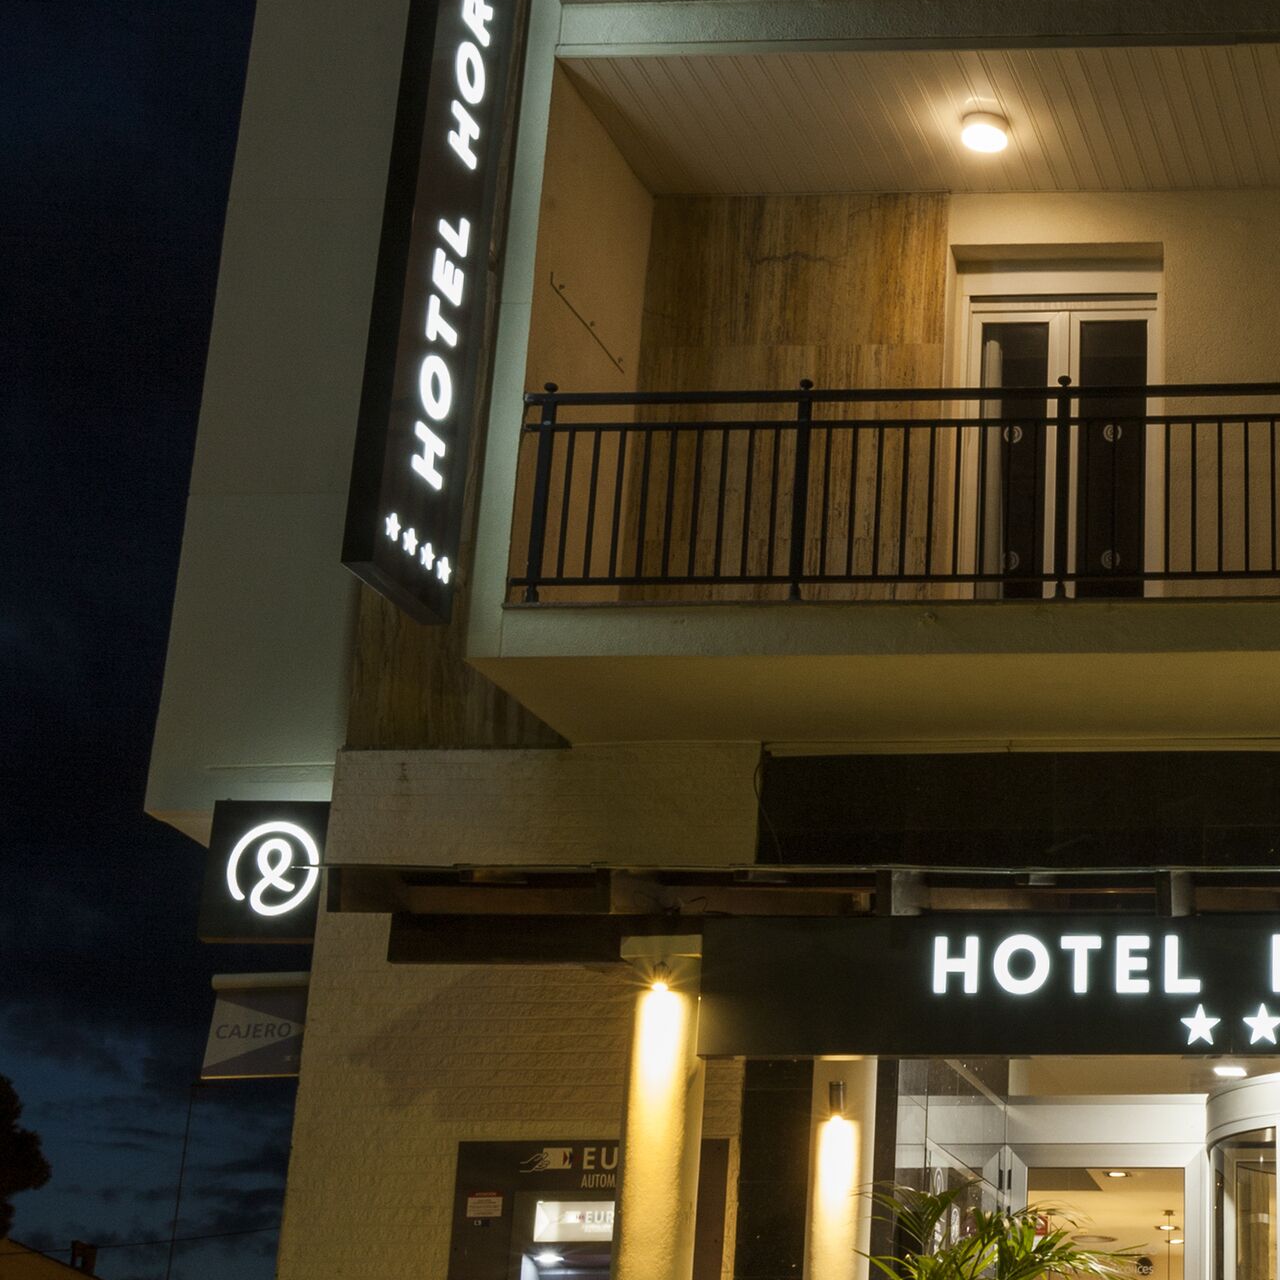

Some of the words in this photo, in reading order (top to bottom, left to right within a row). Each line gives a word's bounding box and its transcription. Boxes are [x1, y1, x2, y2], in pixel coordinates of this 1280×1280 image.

[411, 216, 471, 491] HOTEL
[931, 933, 1202, 995] HOTEL
[216, 1022, 292, 1039] CAJERO
[583, 1147, 619, 1170] EU
[581, 1174, 617, 1189] AUTOM
[585, 1210, 614, 1224] EUR
